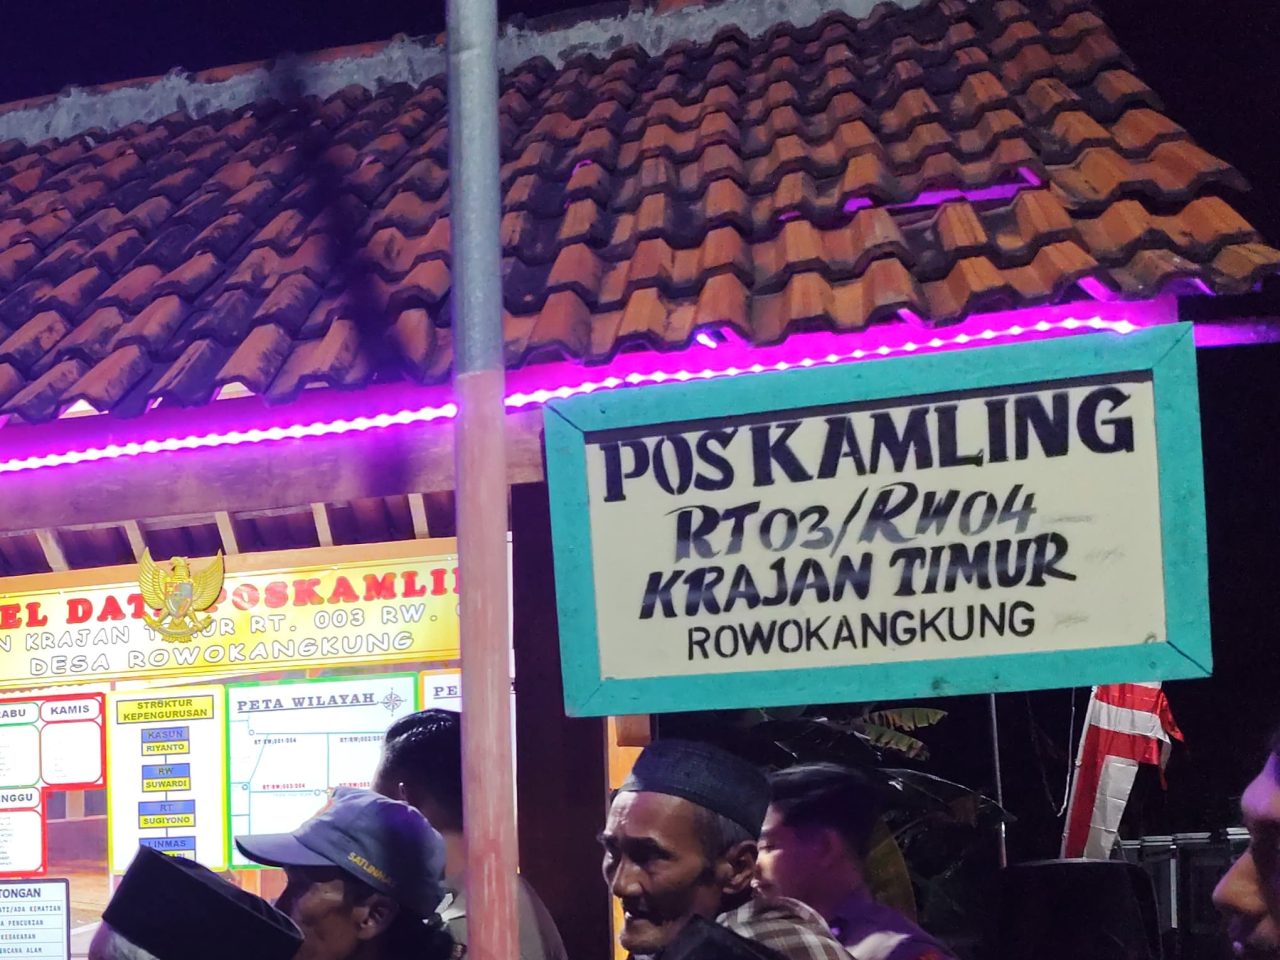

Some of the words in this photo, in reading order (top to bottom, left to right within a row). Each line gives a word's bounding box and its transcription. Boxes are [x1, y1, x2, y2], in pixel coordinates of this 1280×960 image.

[603, 427, 735, 503] POS
[750, 386, 1134, 486] KAMLING
[663, 481, 1037, 564] RT03/RW04
[639, 551, 874, 620] KRAJAN
[888, 531, 1077, 597] TIMUR
[66, 593, 161, 624] DAT
[25, 625, 130, 652] KRAJAN
[249, 614, 297, 633] RT.
[314, 608, 365, 629] 003
[381, 602, 438, 624] RW.
[688, 601, 1036, 661] ROWOKANGKUNG
[30, 652, 110, 680] DESA
[128, 630, 415, 669] ROWOKANGKUNG
[137, 699, 193, 710] STRUKTUR
[237, 698, 283, 711] PETA
[292, 692, 376, 708] WILAYAH
[51, 704, 90, 715] KAMIS
[123, 708, 207, 721] KEPENGURUSAN
[148, 730, 183, 739] KASUN
[146, 743, 185, 752] RIYANTO
[158, 767, 173, 775] RW
[145, 780, 187, 789] SUWARDI
[160, 804, 173, 812] RT
[143, 816, 190, 825] SUGIYONO
